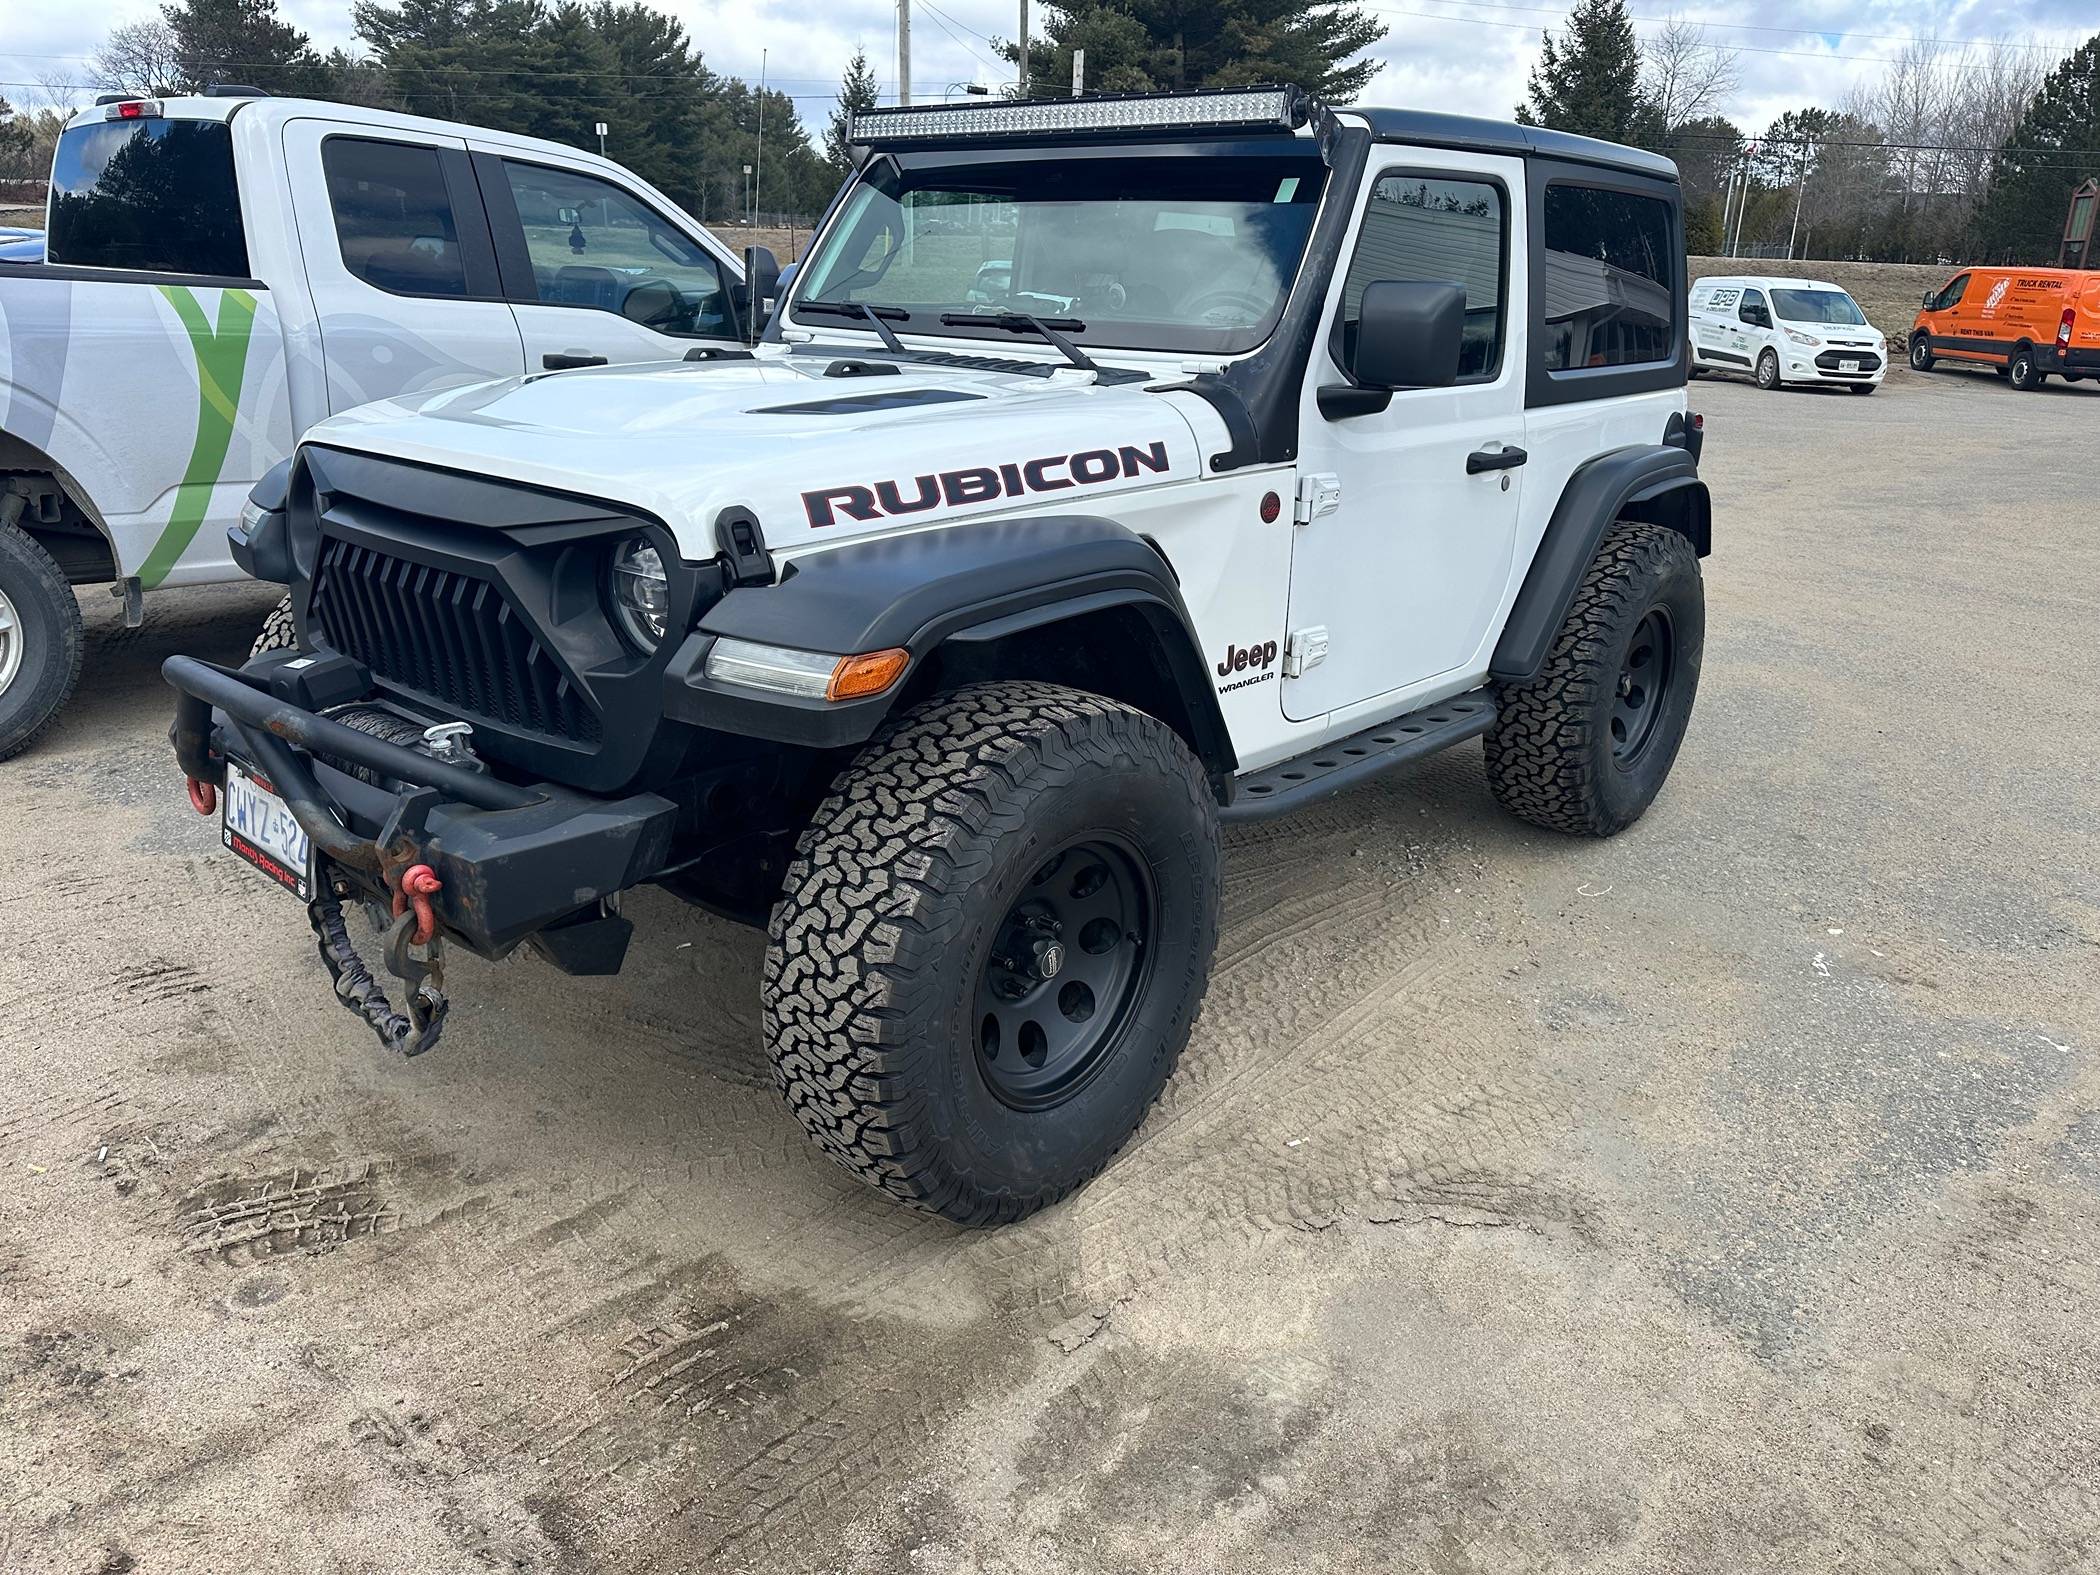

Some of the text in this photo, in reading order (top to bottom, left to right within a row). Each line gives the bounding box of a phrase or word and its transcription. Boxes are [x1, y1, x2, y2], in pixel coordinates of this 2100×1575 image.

[2016, 279, 2063, 289] TRUCK RENTAL
[800, 441, 1170, 529] RUBICON
[1217, 640, 1278, 677] Jeep
[1218, 671, 1275, 695] WRANGLER
[227, 781, 271, 844] CWYZ
[259, 852, 284, 881] Racing
